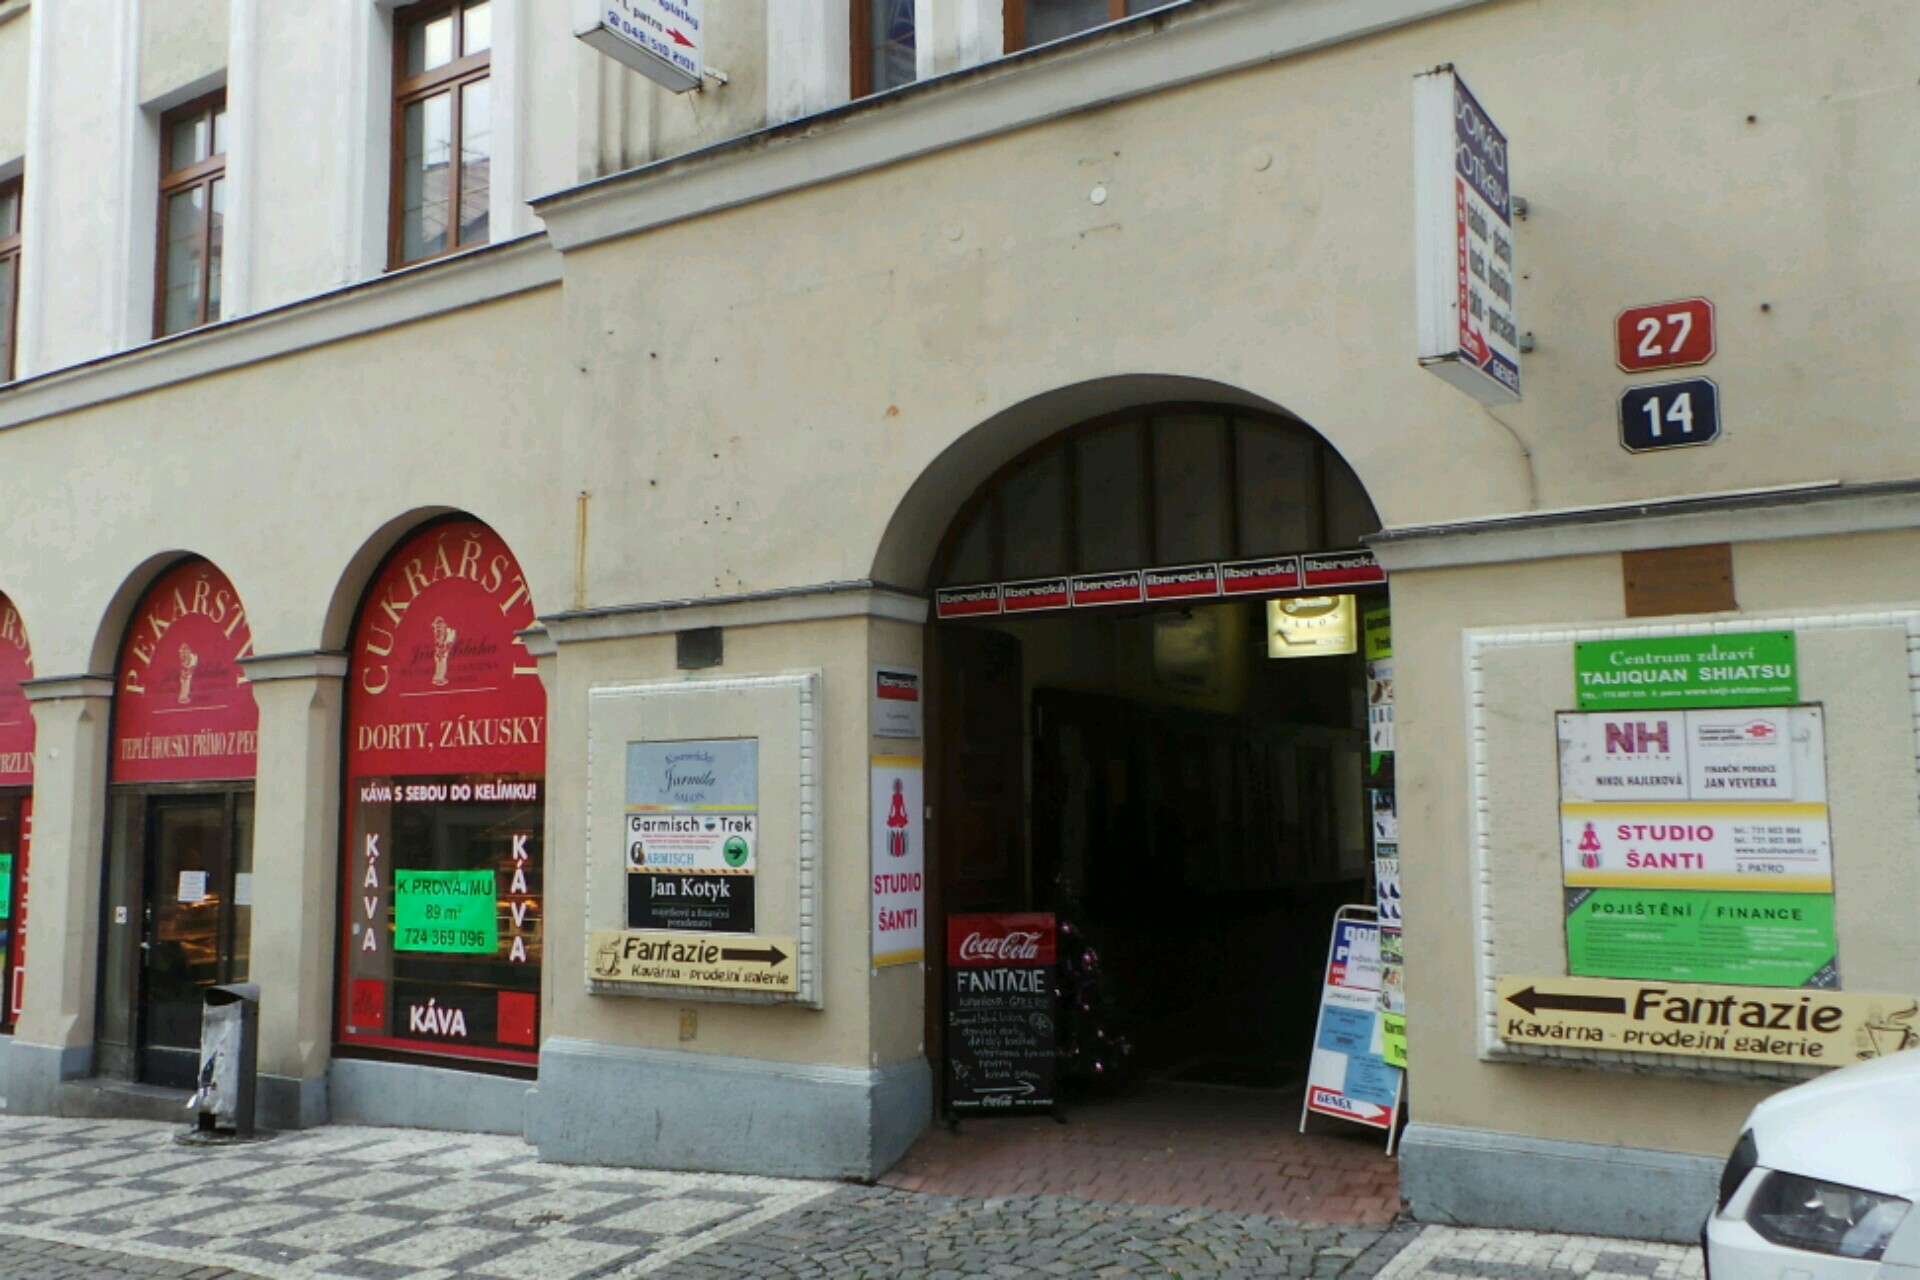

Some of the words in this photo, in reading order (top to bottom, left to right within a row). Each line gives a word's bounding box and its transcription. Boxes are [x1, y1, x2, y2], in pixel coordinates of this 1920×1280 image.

[1637, 312, 1693, 358] 27
[1642, 392, 1694, 438] 14
[1609, 651, 1691, 667] Centrum
[1697, 644, 1755, 662] zdraví
[1580, 668, 1688, 685] TAIJIQUAN
[1698, 664, 1791, 681] SHIATSU
[237, 729, 258, 754] PEC
[358, 721, 434, 752] DORTY,
[439, 714, 544, 748] ZÁKUSKY
[1604, 720, 1670, 754] NH
[361, 782, 392, 803] KÁVA
[394, 784, 403, 802] S
[405, 782, 448, 802] SEBOU
[450, 782, 472, 801] DO
[474, 778, 537, 801] KELÍMKU!
[659, 764, 717, 793] Jarmila
[1703, 778, 1725, 789] JAN
[1728, 777, 1778, 788] VEVERKA
[630, 815, 700, 833] Garmisch
[720, 816, 753, 833] Trek
[1616, 824, 1715, 842] STUDIO
[1625, 850, 1705, 869] ŠANTI
[399, 879, 407, 895] K
[412, 877, 493, 896] PRONÁJMU
[650, 877, 677, 898] Jan
[681, 878, 731, 902] Kotyk
[873, 872, 922, 895] STUDIO
[426, 904, 441, 920] 89
[878, 907, 918, 932] ŠANTI
[1591, 901, 1693, 918] POJIŠTĚNÍ
[1716, 907, 1803, 921] FINANCE
[404, 928, 428, 946] 724
[432, 929, 455, 947] 369
[459, 930, 485, 948] 096
[959, 931, 1044, 961] Coca-Cola
[622, 938, 721, 964] Fantazie
[631, 964, 681, 979] Kavárna
[957, 968, 1046, 993] FANTAZIE
[409, 997, 467, 1037] KÁVA
[1632, 988, 1844, 1034] Fantazie
[1507, 1018, 1603, 1043] Kavárna
[1622, 1028, 1726, 1053] prodejní
[1737, 1033, 1825, 1058] galerie
